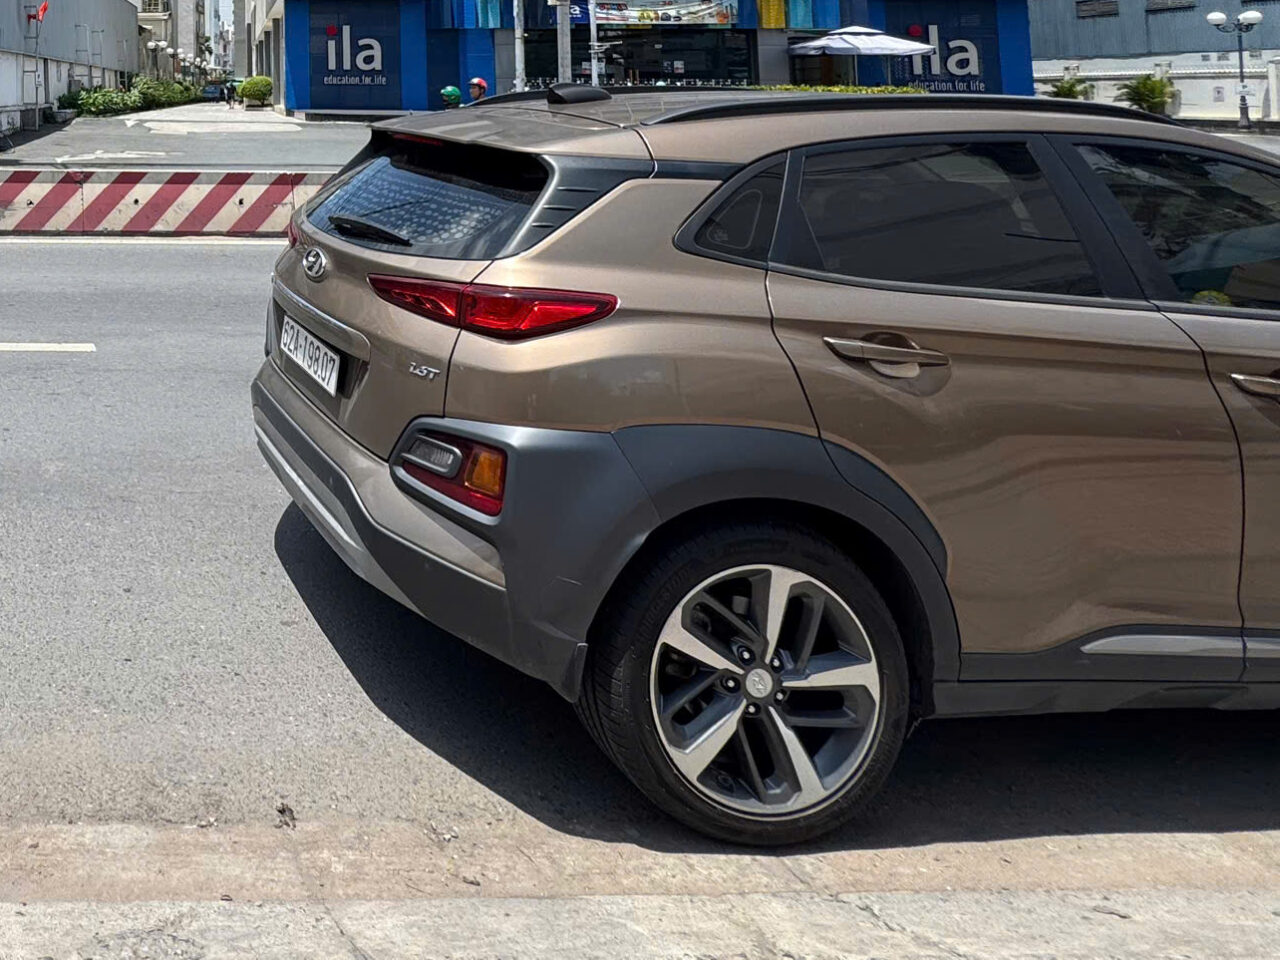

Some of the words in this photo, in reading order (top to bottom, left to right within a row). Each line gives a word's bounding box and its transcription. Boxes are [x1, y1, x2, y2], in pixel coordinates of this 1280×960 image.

[326, 24, 382, 71] ila
[907, 24, 980, 76] ila
[324, 74, 361, 85] education
[362, 74, 372, 85] for
[374, 74, 387, 85] life
[908, 80, 953, 91] education
[955, 80, 968, 91] for
[970, 80, 985, 91] life
[282, 320, 336, 387] 62A-198.07
